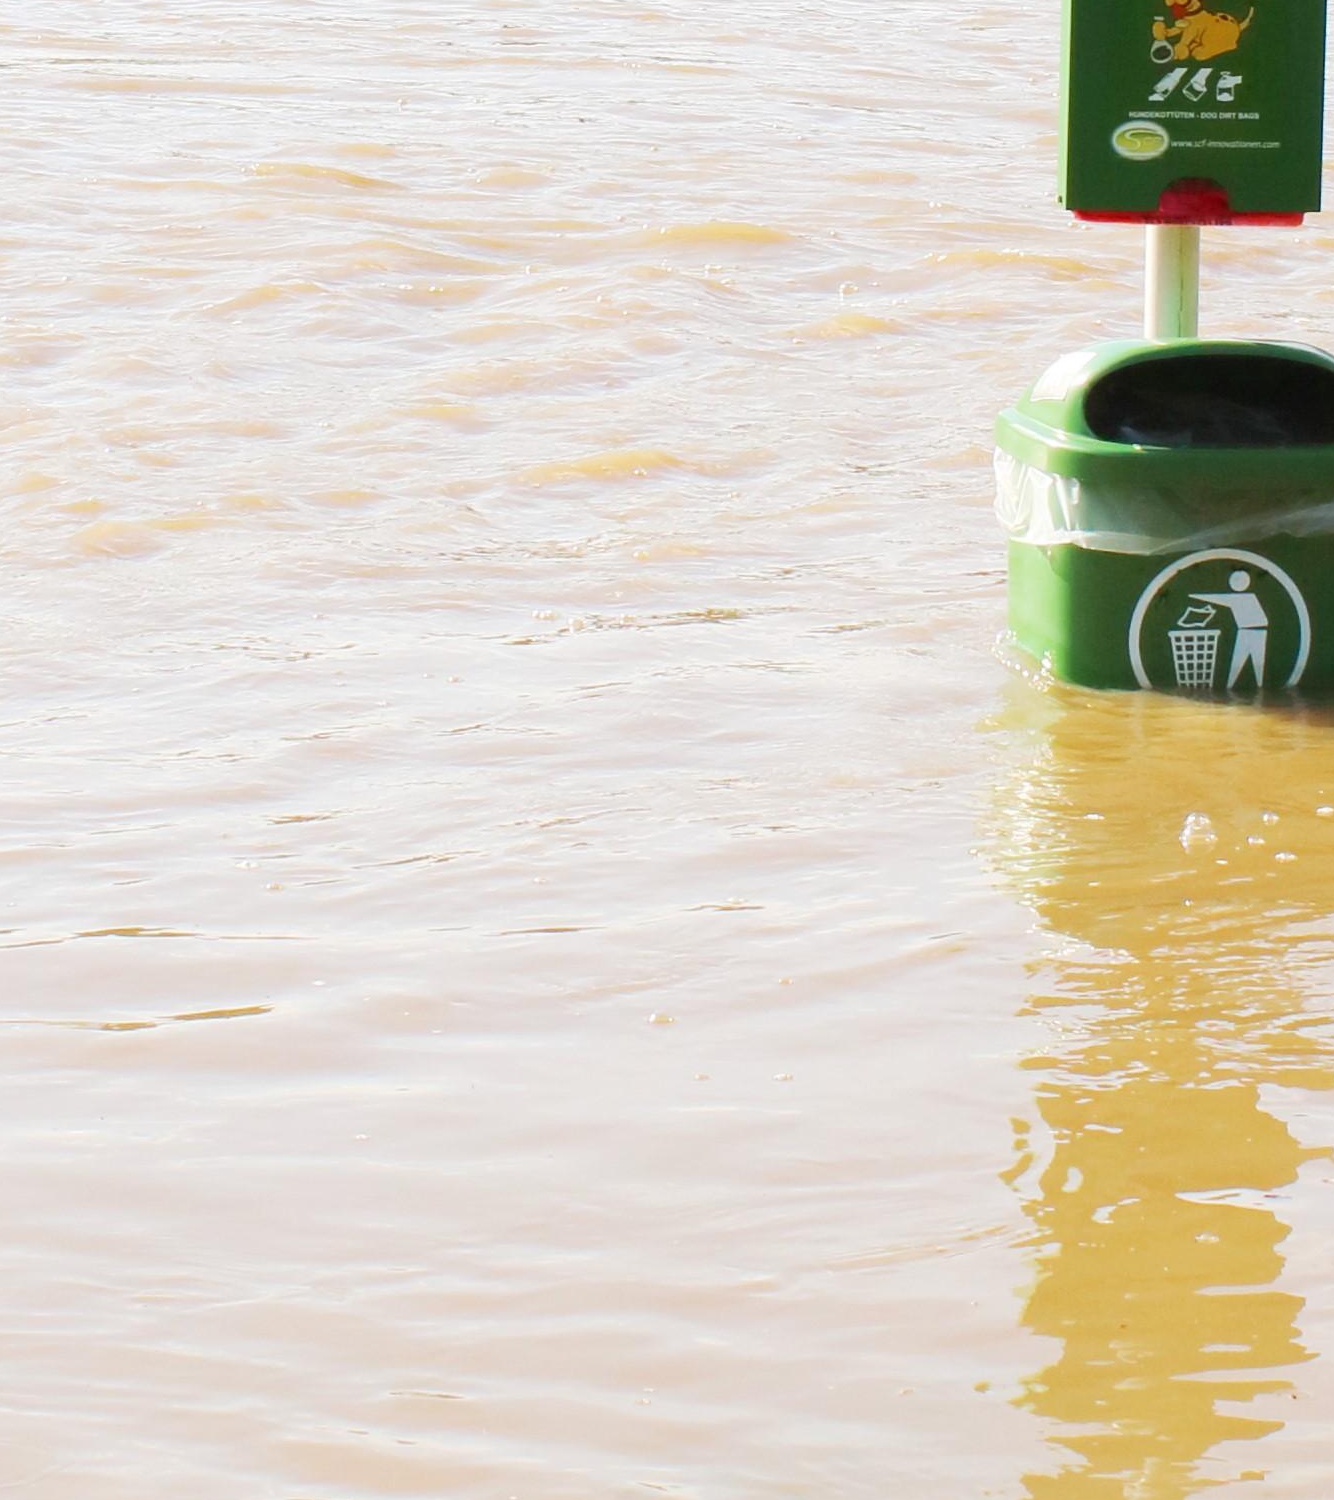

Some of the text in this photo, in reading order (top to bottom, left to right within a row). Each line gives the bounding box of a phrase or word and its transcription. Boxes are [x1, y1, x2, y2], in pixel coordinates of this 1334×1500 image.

[1200, 112, 1218, 120] DOG
[1218, 112, 1236, 120] DIRT
[1237, 112, 1260, 120] BAGS
